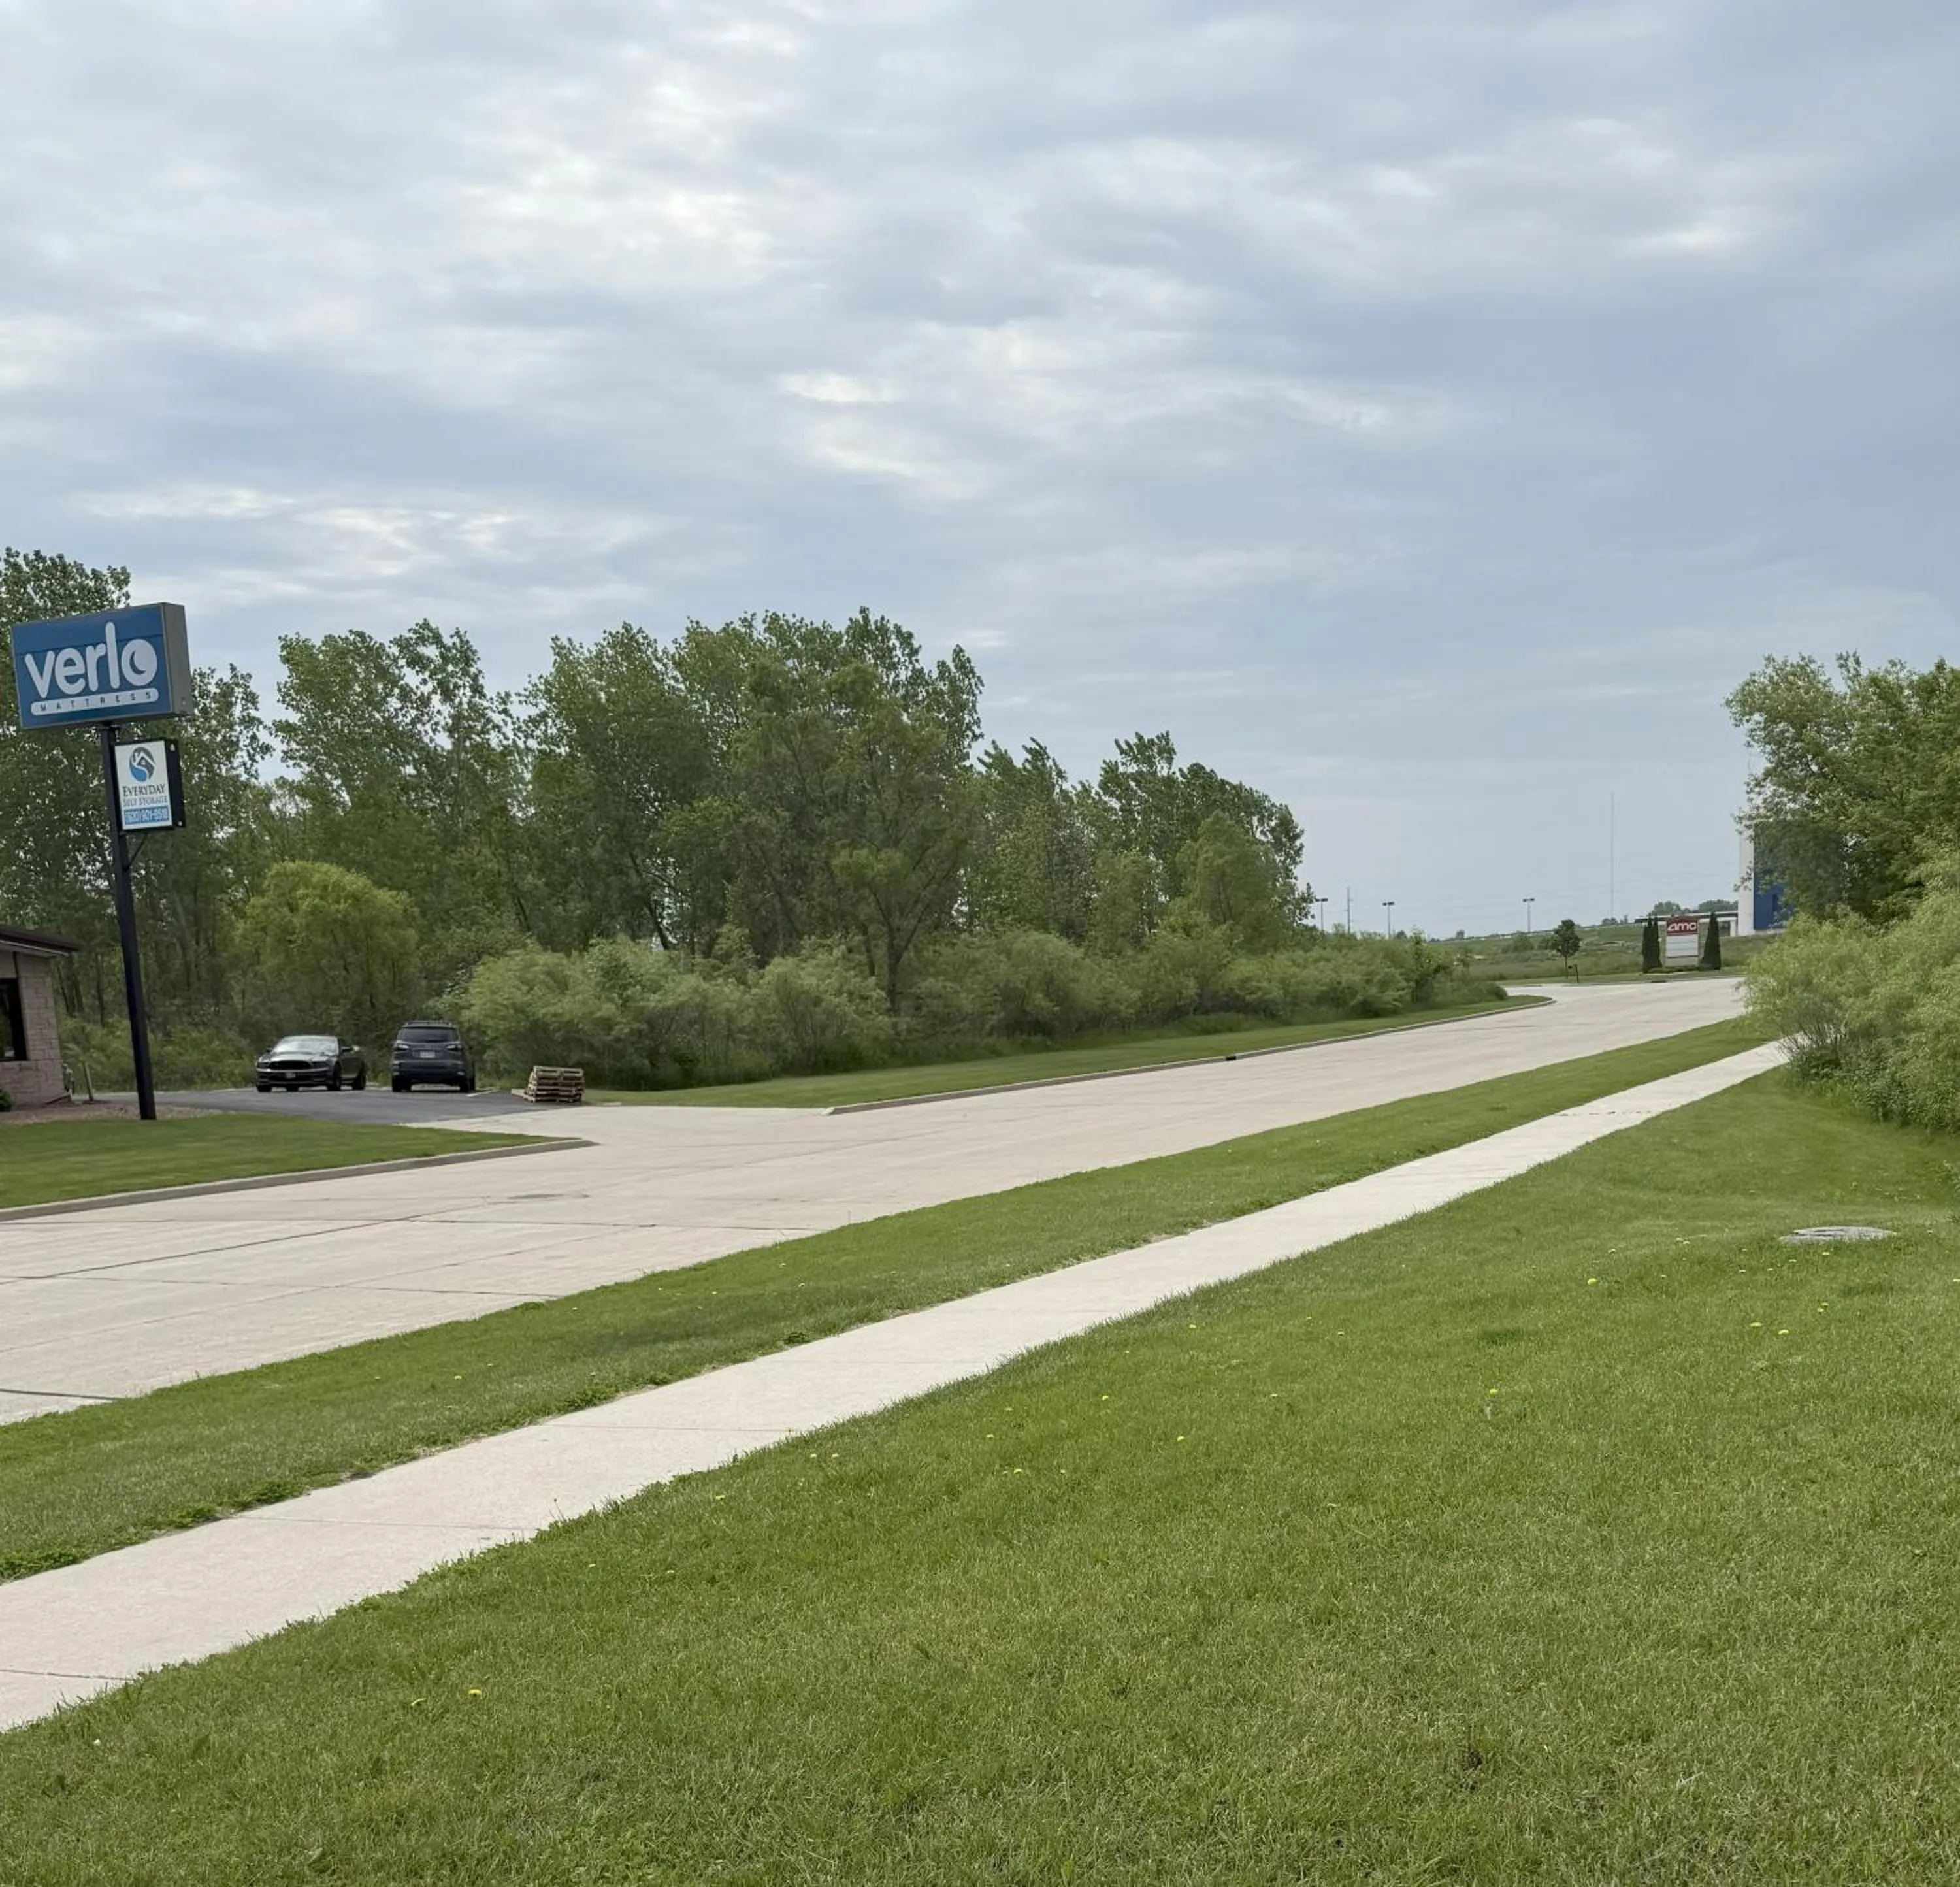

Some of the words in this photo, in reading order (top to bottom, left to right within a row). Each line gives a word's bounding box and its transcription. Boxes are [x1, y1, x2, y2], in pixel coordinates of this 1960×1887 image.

[24, 621, 157, 698] verlo
[40, 692, 152, 712] MATTRESS
[122, 784, 165, 796] EVERYDAY
